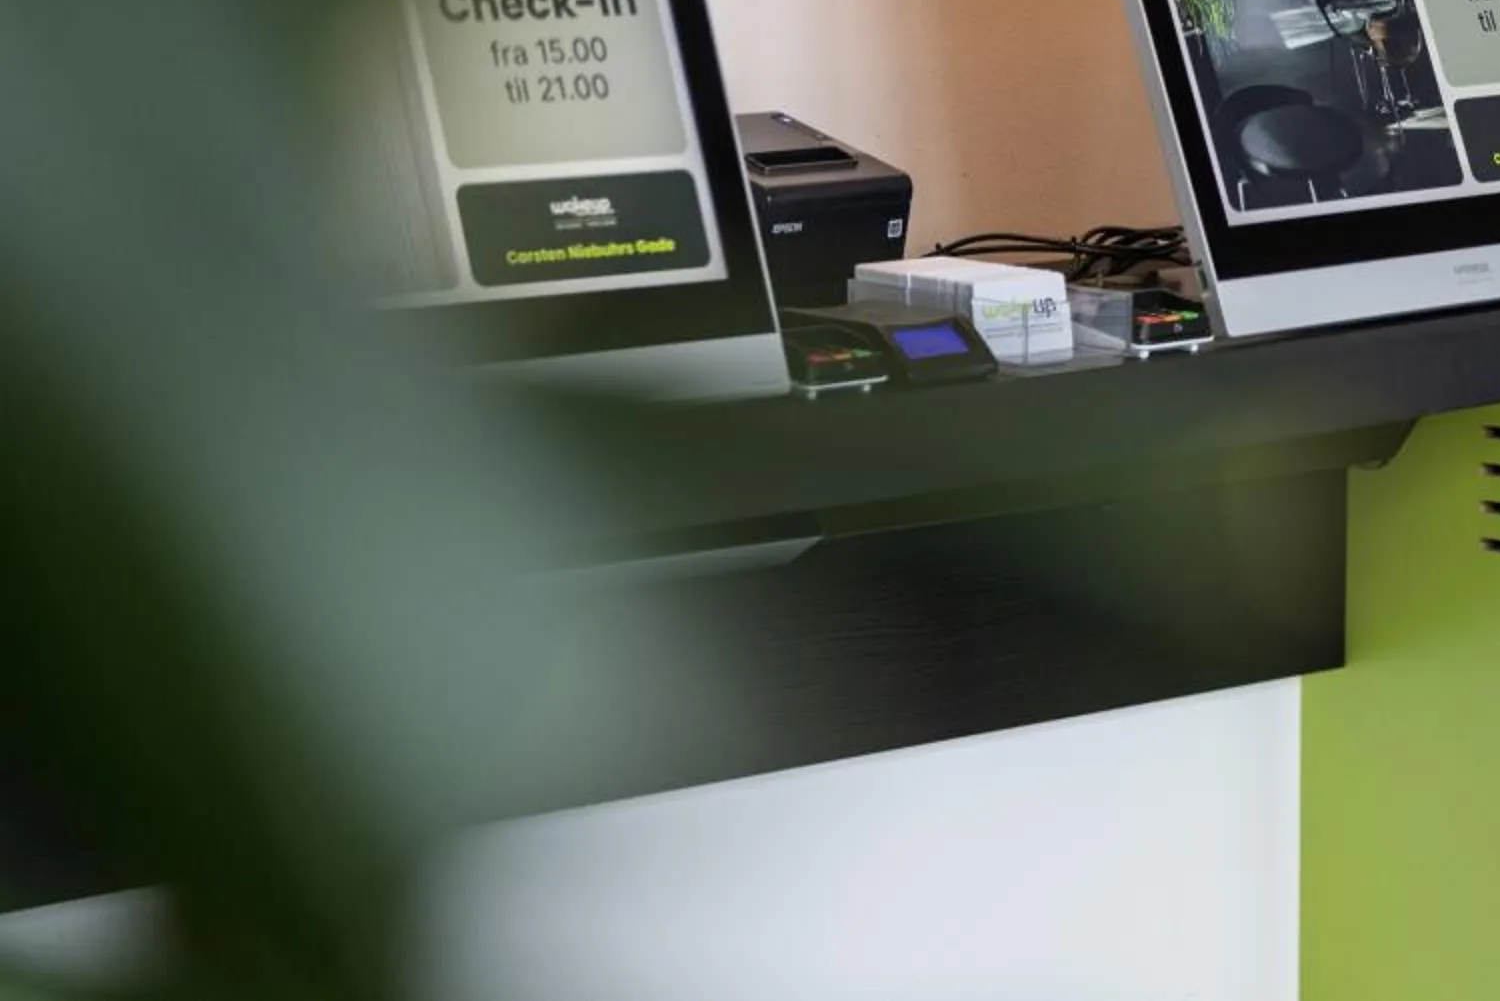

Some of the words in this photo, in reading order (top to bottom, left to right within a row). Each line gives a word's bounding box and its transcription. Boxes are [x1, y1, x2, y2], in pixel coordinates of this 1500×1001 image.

[1477, 9, 1497, 33] til
[489, 41, 529, 68] fra
[535, 36, 609, 66] 15.00
[504, 79, 530, 105] til
[537, 73, 610, 103] 21.00
[506, 249, 566, 265] Carsten
[566, 243, 635, 259] Niebuhrs
[635, 236, 676, 253] Gade
